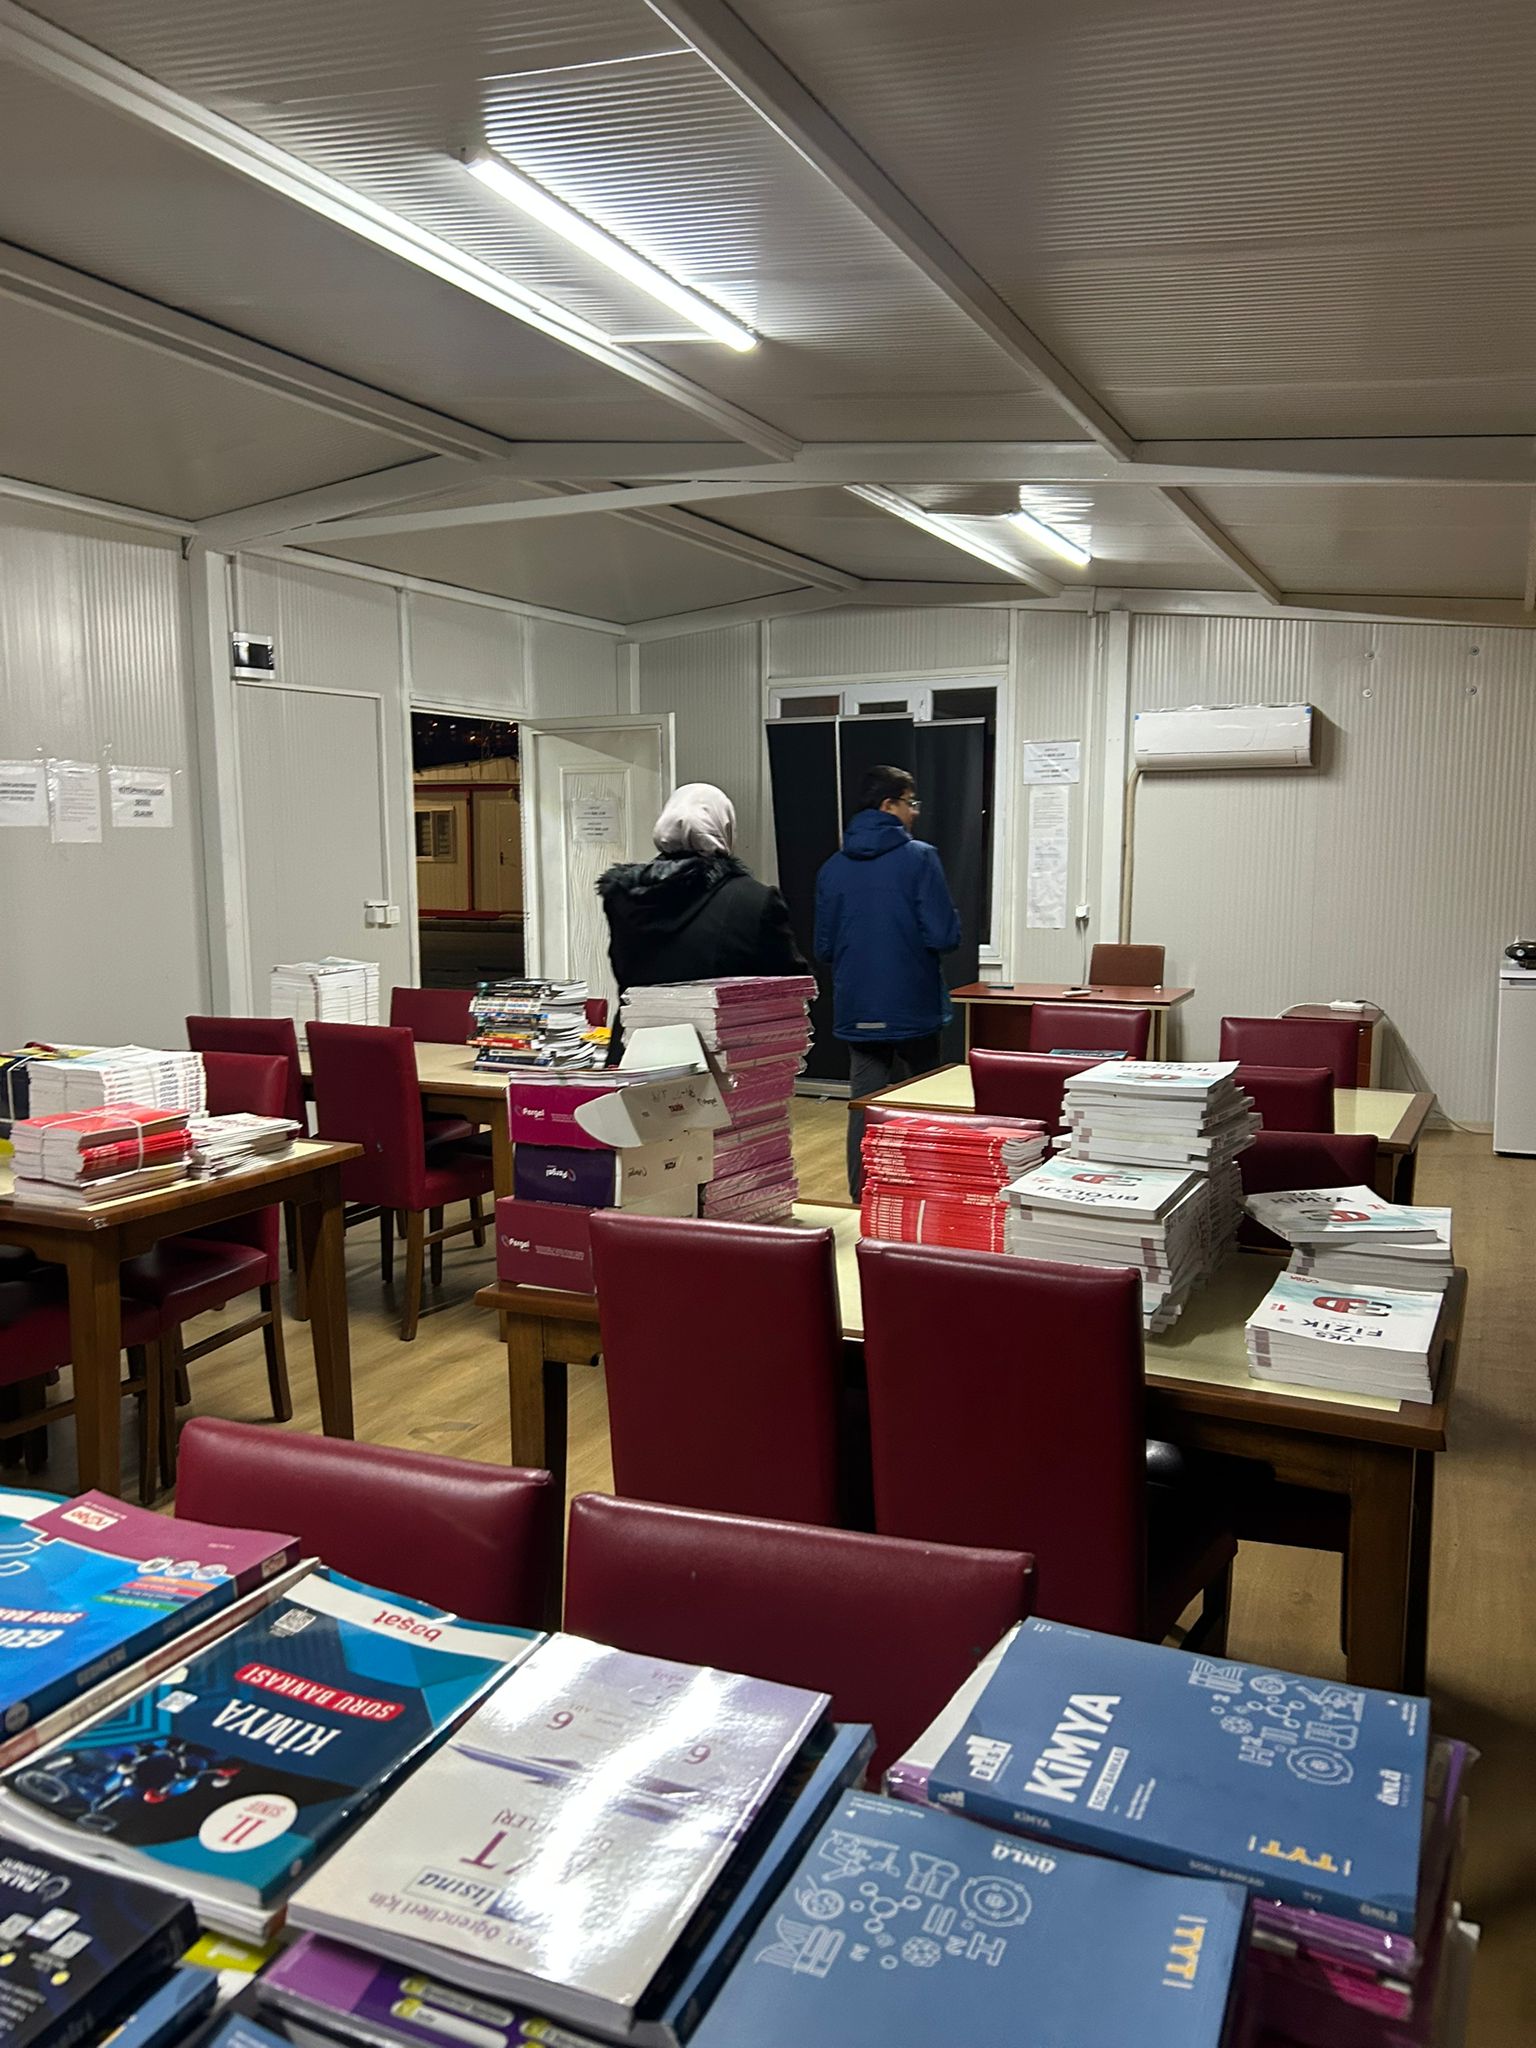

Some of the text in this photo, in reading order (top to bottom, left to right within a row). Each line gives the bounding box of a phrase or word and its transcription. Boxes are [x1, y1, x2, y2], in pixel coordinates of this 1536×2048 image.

[1315, 1330, 1356, 1343] YKS
[247, 1666, 396, 1719] SORU BANKASI
[212, 1698, 343, 1757] KİMYA
[1164, 1924, 1205, 1981] TYT
